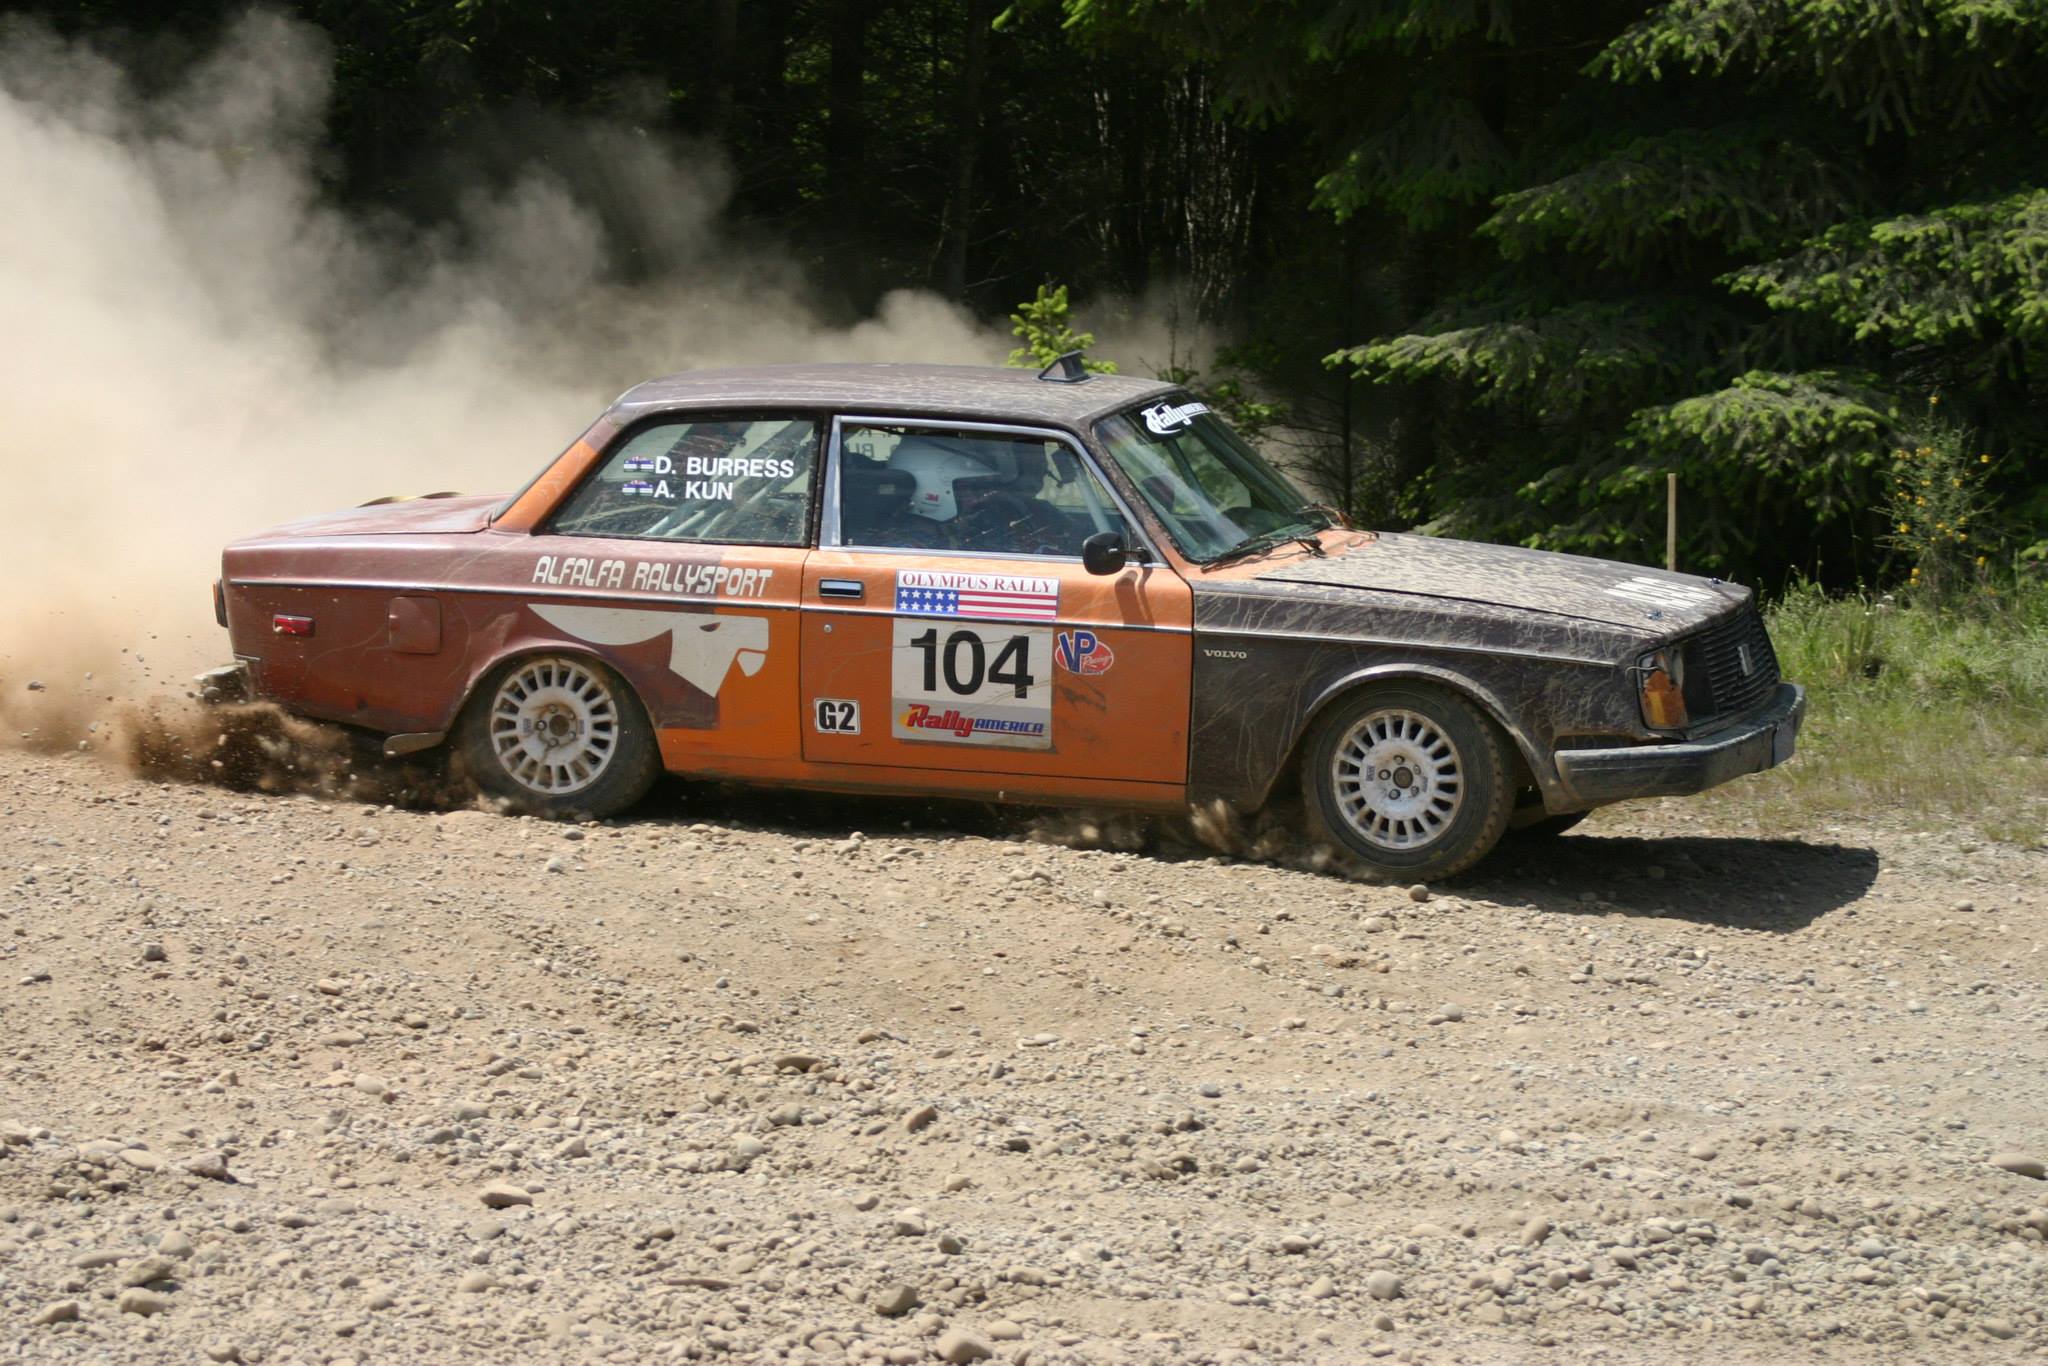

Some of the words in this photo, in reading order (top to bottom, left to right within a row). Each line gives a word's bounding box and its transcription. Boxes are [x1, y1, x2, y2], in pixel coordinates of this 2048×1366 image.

[655, 455, 677, 475] D.
[686, 456, 795, 478] BURRESS
[653, 479, 676, 499] A.
[684, 480, 734, 501] KUN
[532, 556, 626, 588] ALFALFA
[632, 562, 773, 597] RALLYSPORT
[902, 572, 988, 590] OLYMPUS
[994, 578, 1053, 593] RALLY
[910, 628, 1034, 699] 104
[1058, 630, 1097, 673] VP
[1203, 649, 1248, 660] VOLVO
[818, 701, 856, 731] G2
[907, 703, 975, 738] Rally
[974, 718, 1045, 735] AMERICA
